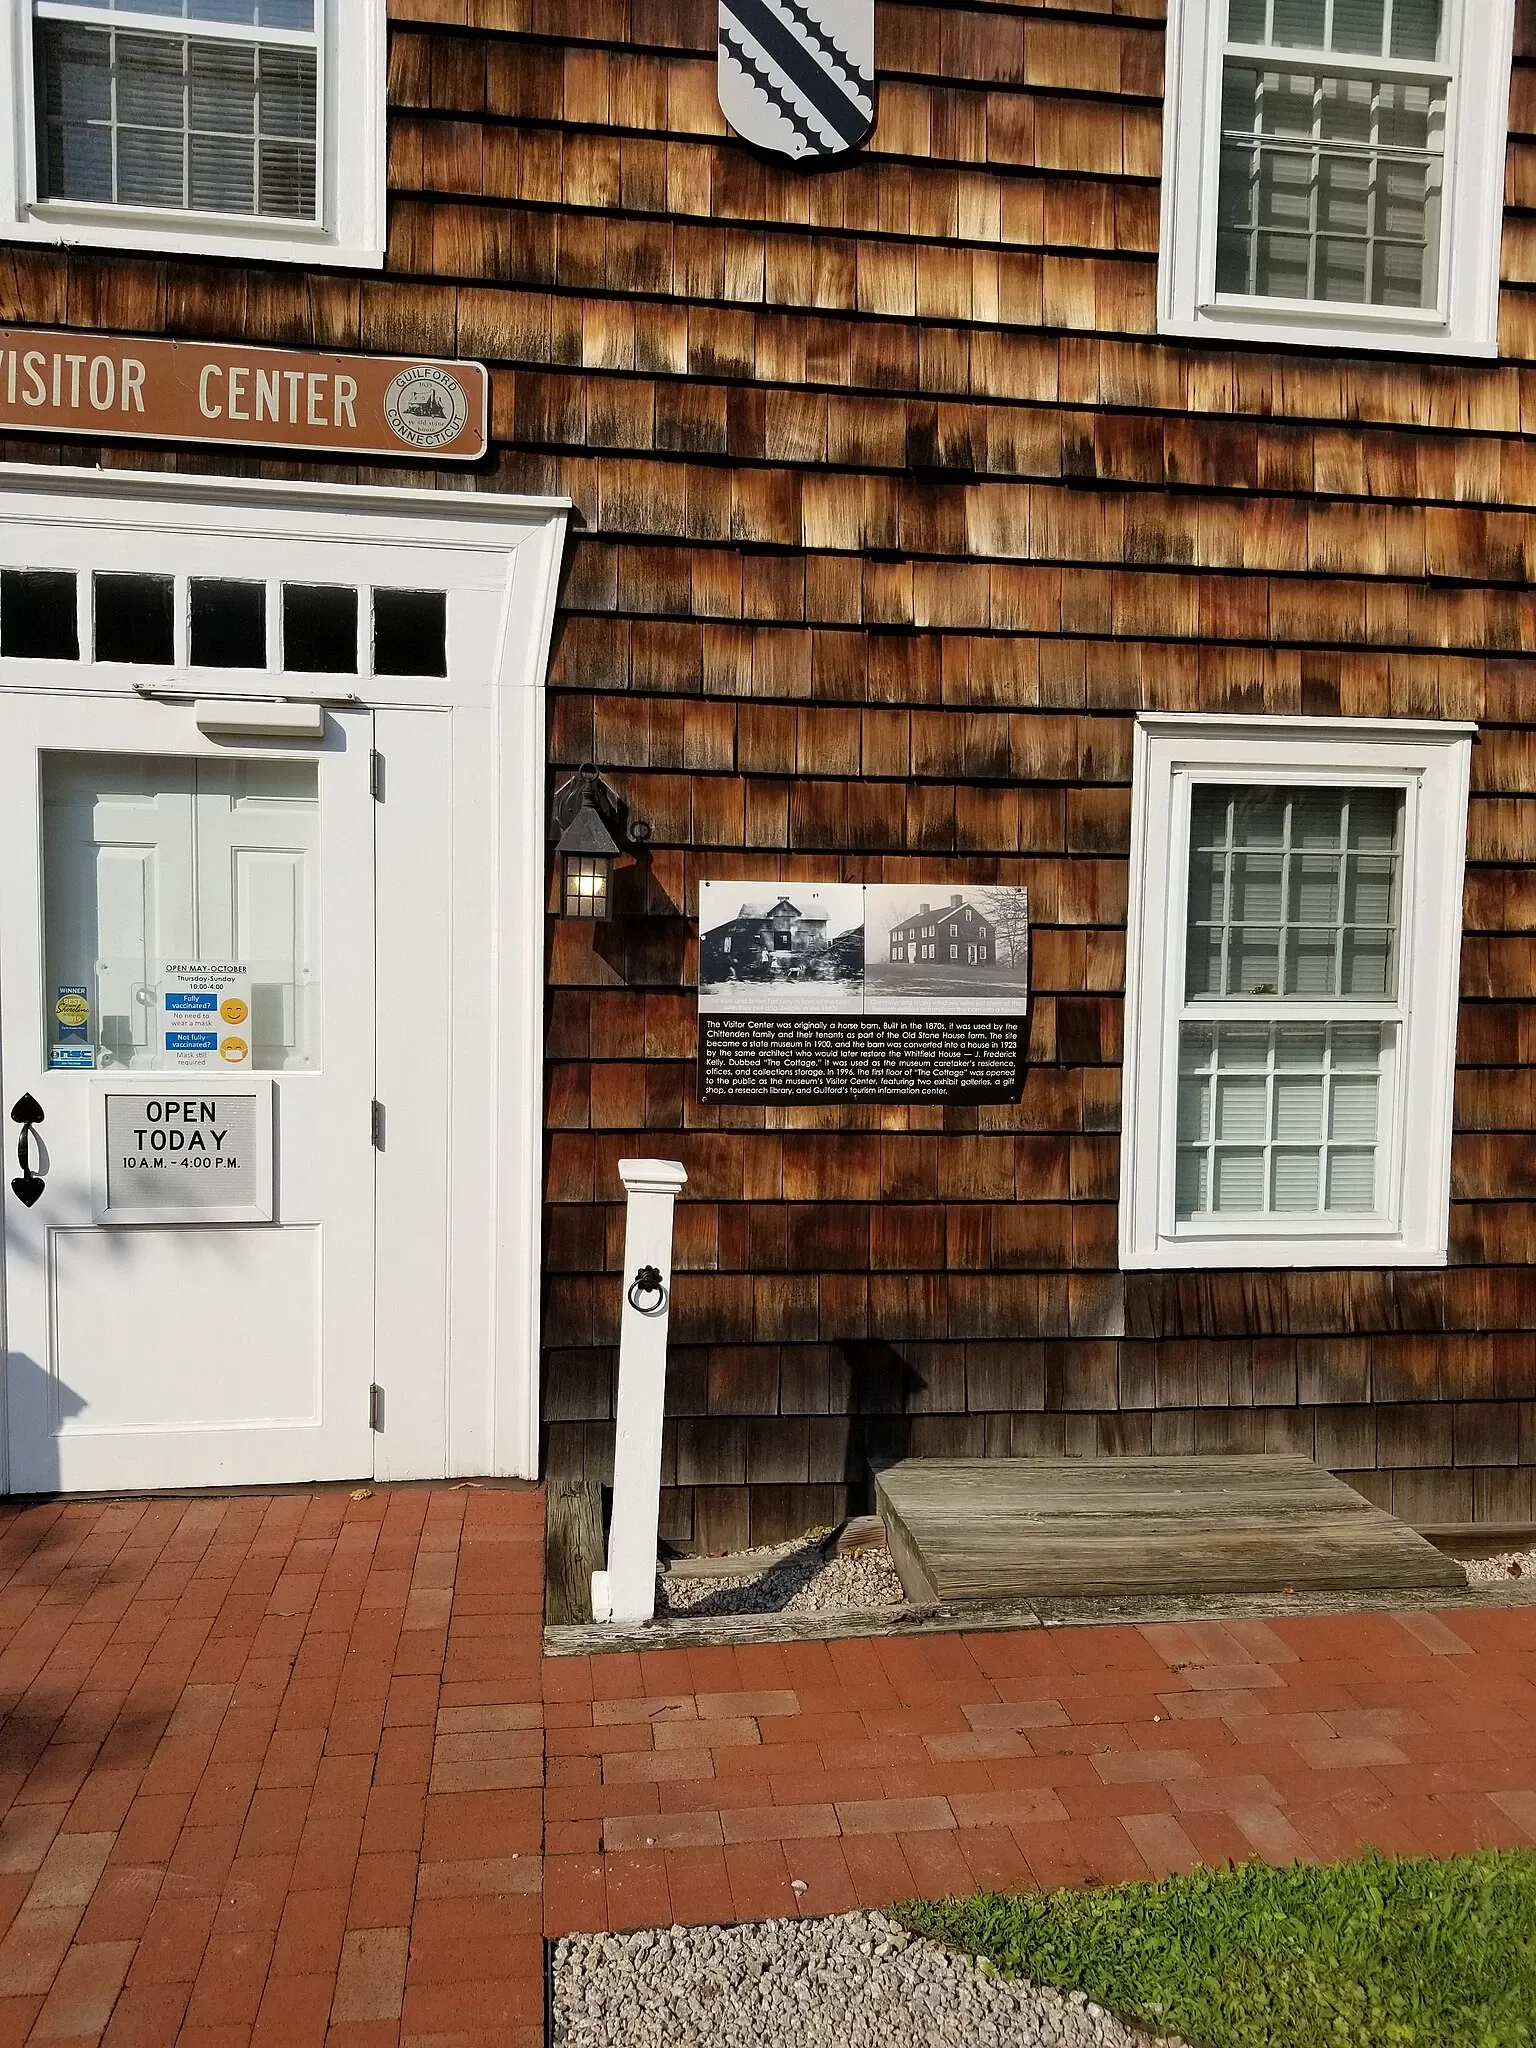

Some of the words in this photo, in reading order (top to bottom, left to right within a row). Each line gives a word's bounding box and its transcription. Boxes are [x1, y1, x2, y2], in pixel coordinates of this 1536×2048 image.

[396, 369, 457, 391] GUILFORD
[0, 350, 145, 412] ISITOR
[200, 364, 358, 427] CENTER
[388, 409, 463, 445] CONNECTICUT
[794, 1021, 827, 1031] originally
[994, 1022, 1003, 1031] by
[753, 1030, 775, 1040] family
[858, 1031, 873, 1040] part
[707, 1049, 716, 1058] by
[706, 1058, 725, 1068] Kelly.
[795, 1068, 825, 1078] storage.
[986, 1069, 1015, 1078] opened
[732, 1077, 756, 1086] public
[881, 1078, 914, 1087] featuring
[1003, 1078, 1014, 1088] gift
[146, 1101, 216, 1122] OPEN
[134, 1130, 228, 1150] TODAY
[123, 1158, 136, 1168] 10
[140, 1158, 167, 1168] A.M.
[180, 1157, 211, 1168] 4:00
[216, 1158, 240, 1168] P.M.
